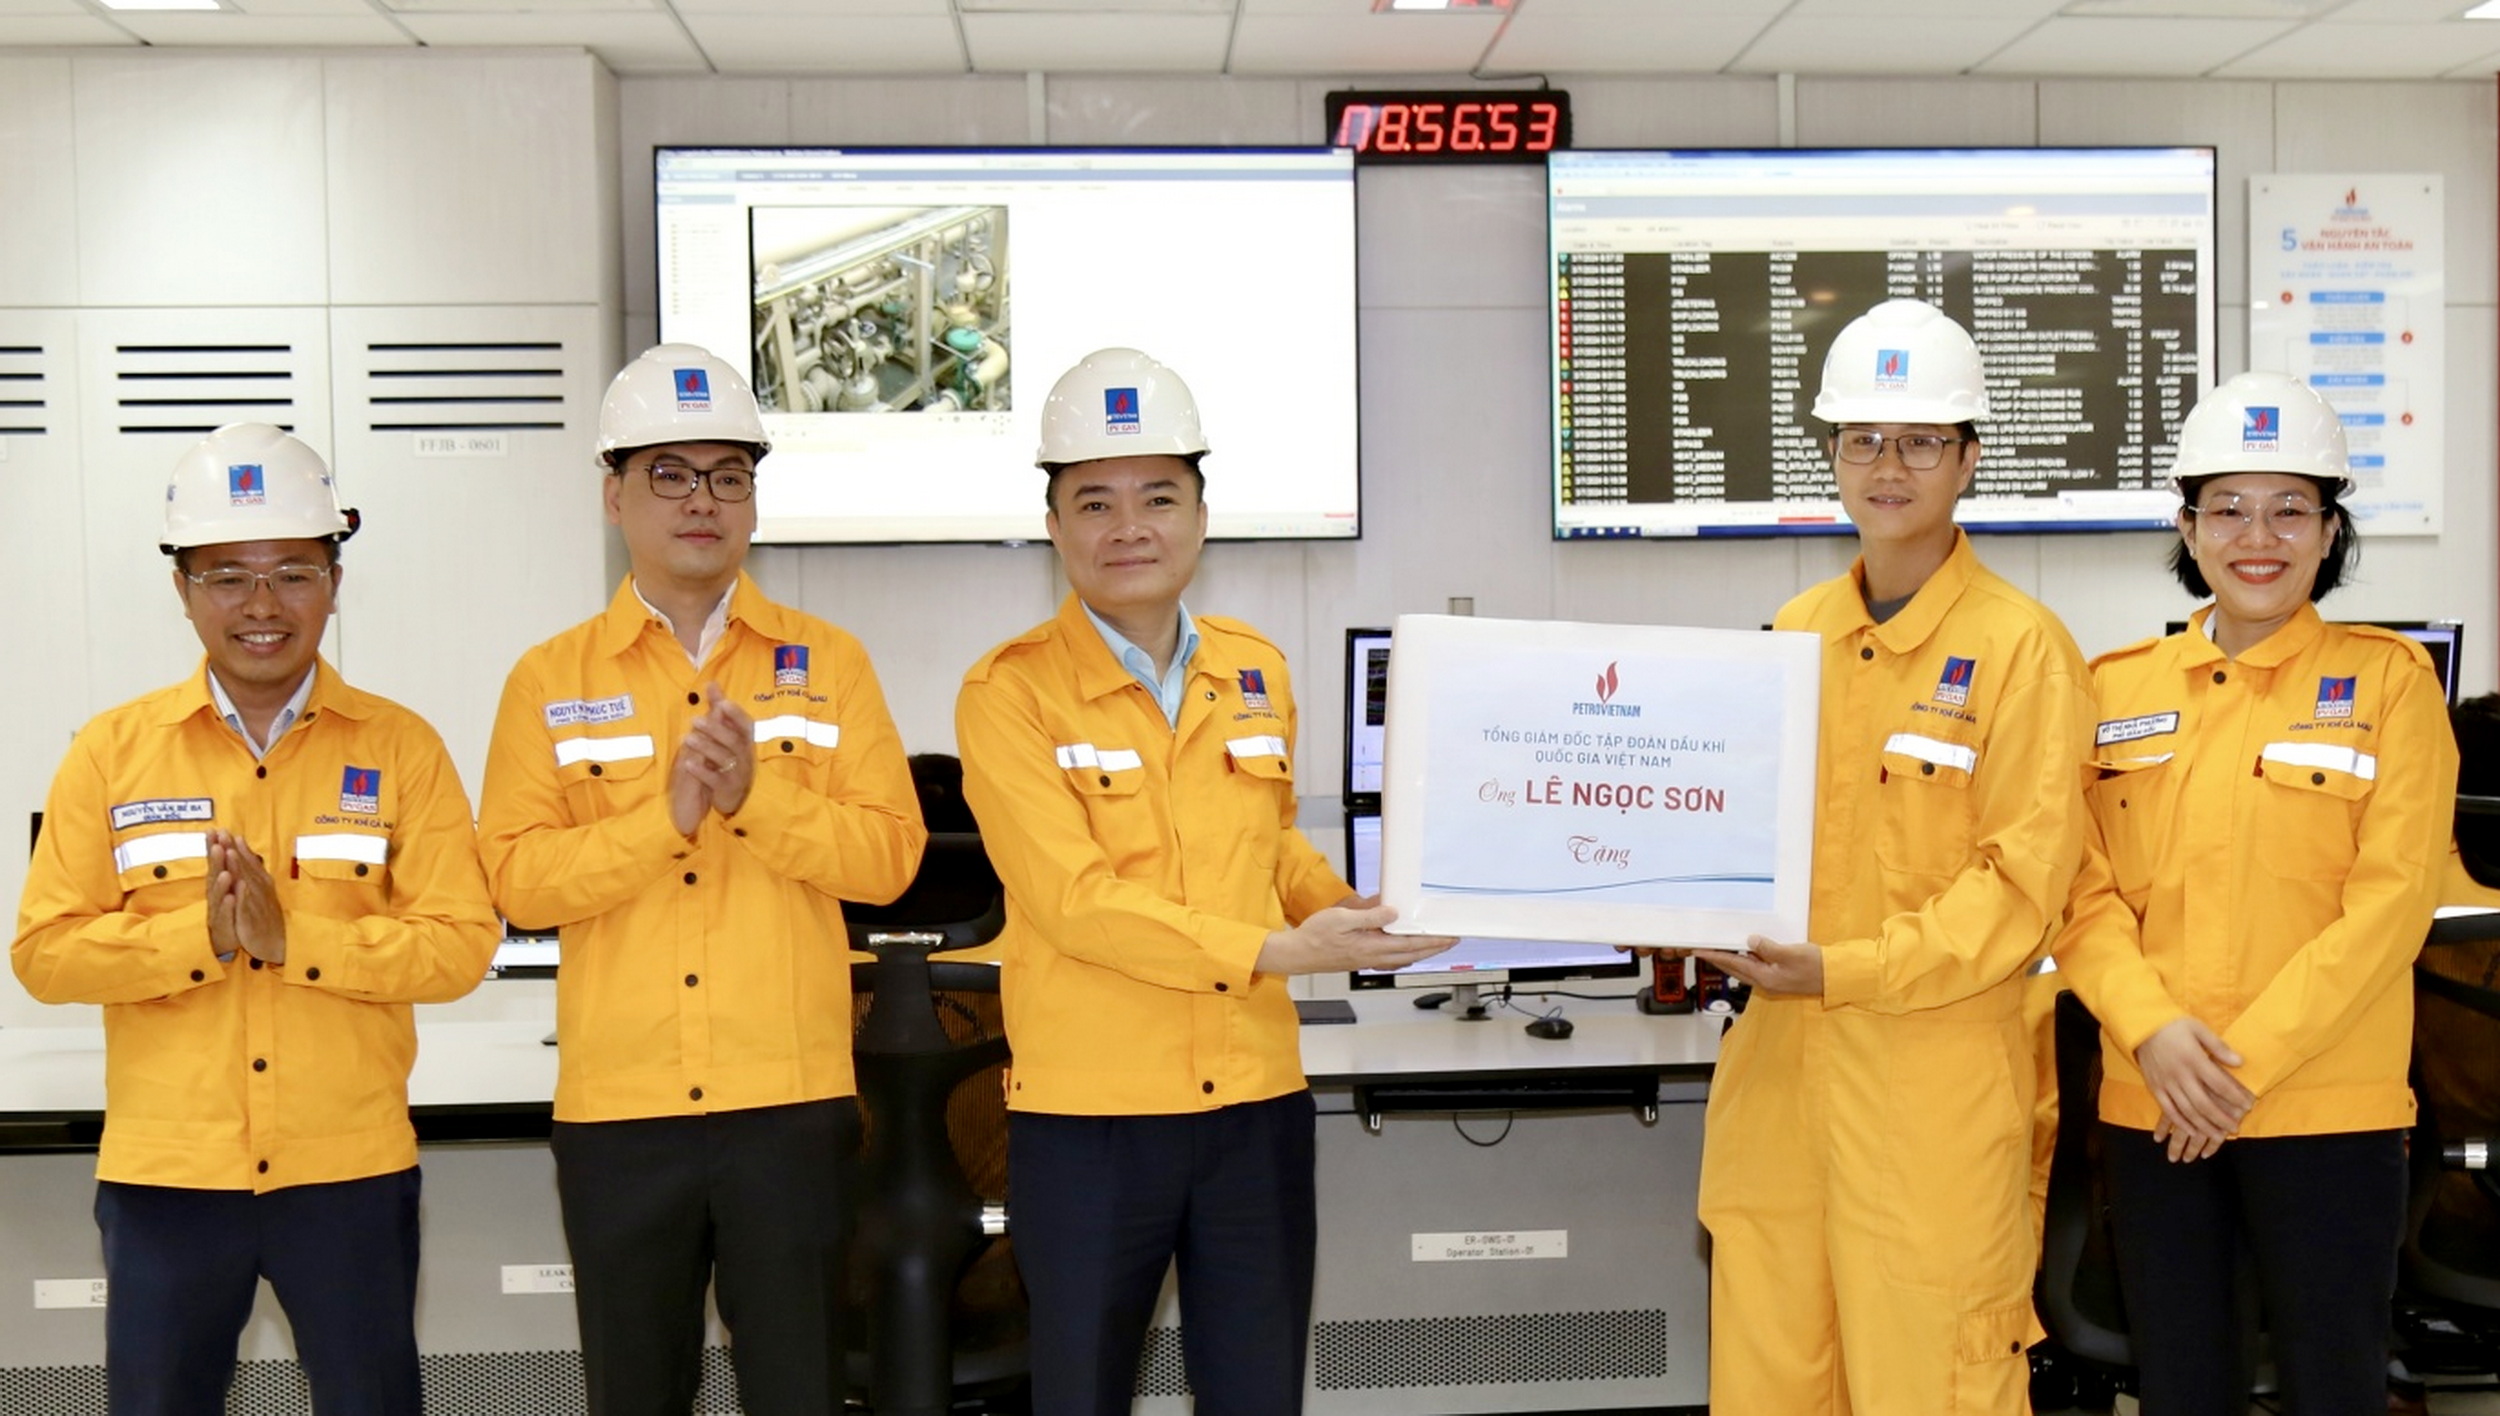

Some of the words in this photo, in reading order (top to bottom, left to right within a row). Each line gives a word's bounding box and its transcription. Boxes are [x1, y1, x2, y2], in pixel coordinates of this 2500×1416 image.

[2281, 228, 2297, 251] 5
[1572, 702, 1641, 718] PETROVIETNAM
[1483, 725, 1520, 743] TỔNG
[1524, 729, 1559, 745] GIÁM
[1563, 729, 1592, 747] ĐỐC
[1597, 731, 1623, 750] TẬP
[1627, 734, 1667, 750] ĐOÀN
[1670, 735, 1699, 752] DẦU
[1703, 737, 1725, 754] KHÍ
[1535, 748, 1574, 765] QUỐC
[1577, 751, 1601, 765] GIA
[1604, 751, 1636, 770] VIỆT
[1640, 754, 1672, 768] NAM
[1526, 775, 1563, 806] LÊ
[1572, 782, 1655, 815] NGỌC
[1663, 785, 1725, 813] SƠN
[1567, 835, 1631, 869] Tặng
[1446, 1247, 1485, 1259] Operator
